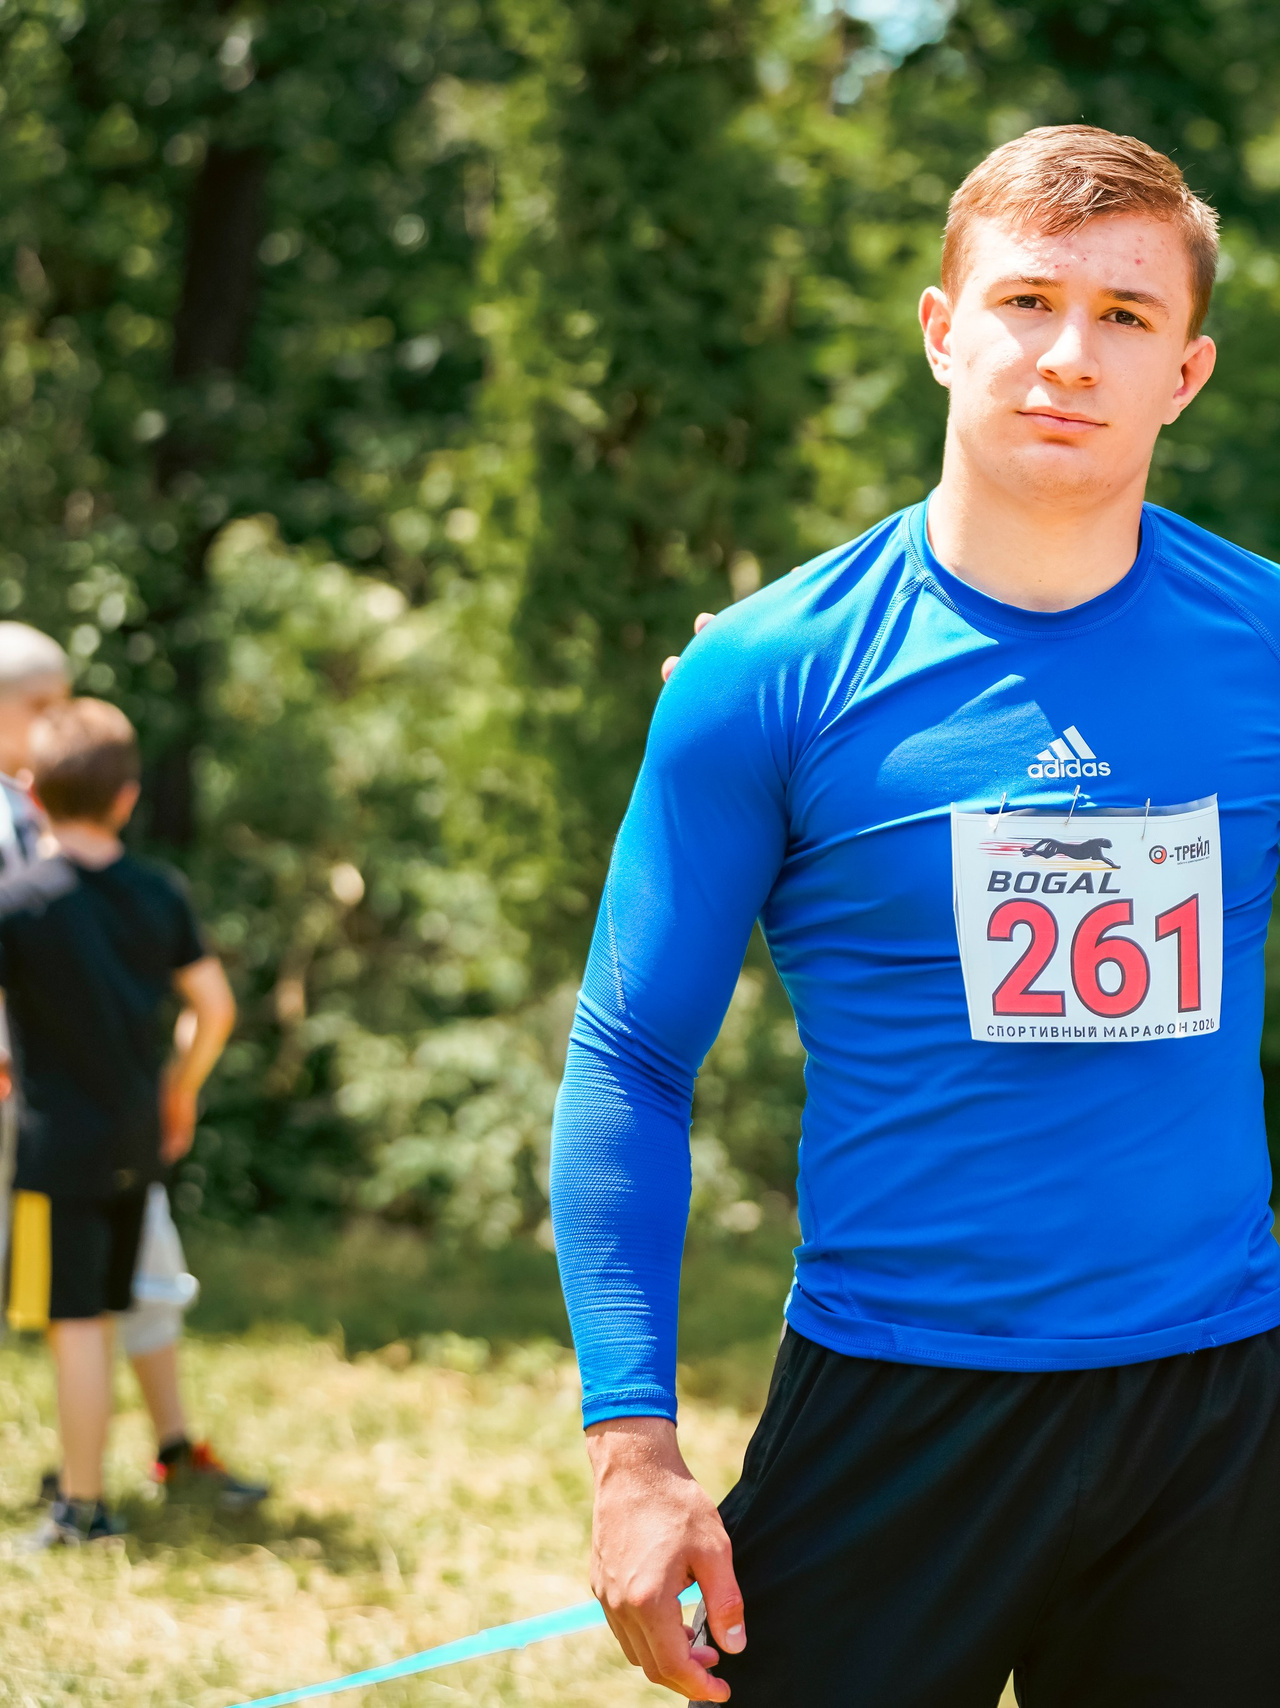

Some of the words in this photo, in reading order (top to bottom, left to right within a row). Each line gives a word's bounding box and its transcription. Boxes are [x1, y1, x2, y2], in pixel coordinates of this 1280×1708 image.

[1027, 759, 1111, 779] adidas
[987, 870, 1121, 894] BOGAL
[987, 893, 1202, 1019] 261
[987, 1025, 1098, 1038] СПОРТИВНЫЙ
[1103, 1022, 1188, 1038] МАРАФОН
[1192, 1017, 1215, 1032] 2026
